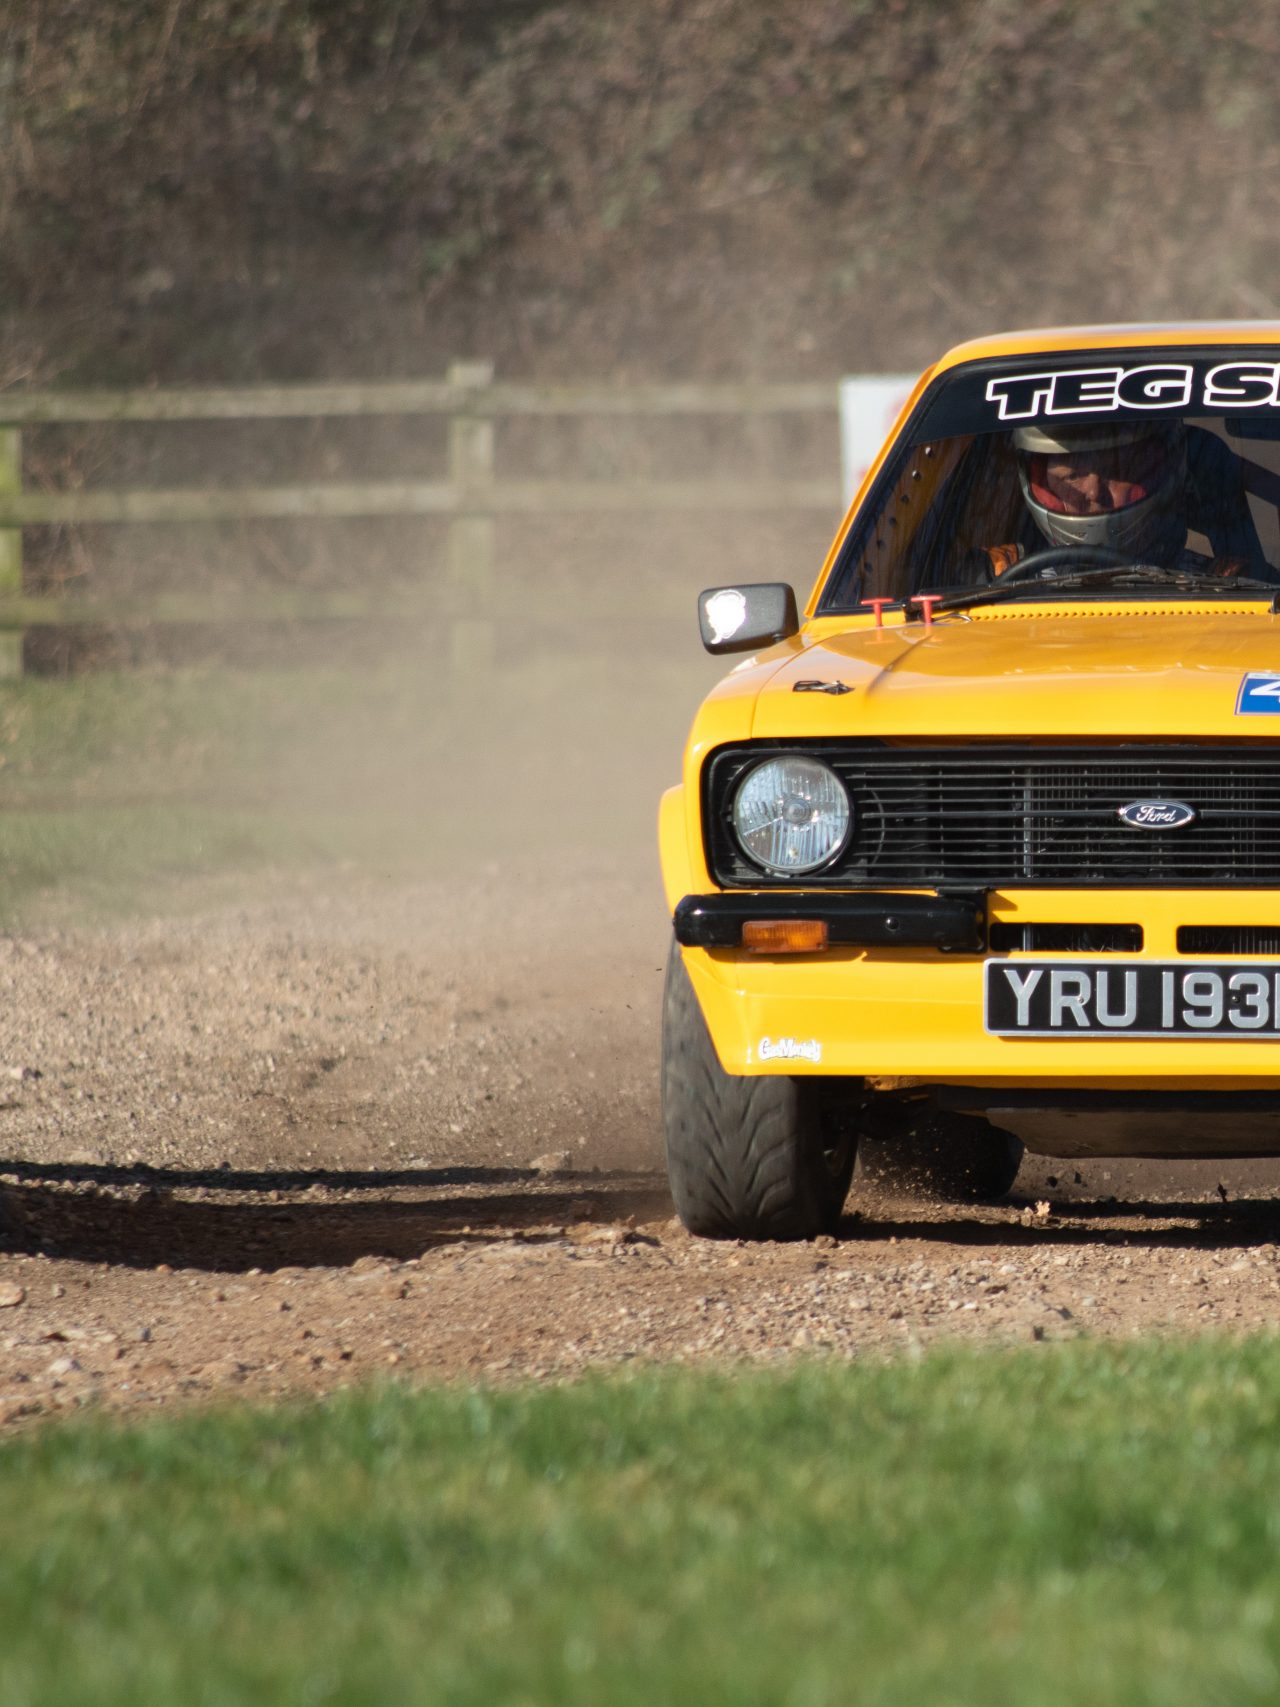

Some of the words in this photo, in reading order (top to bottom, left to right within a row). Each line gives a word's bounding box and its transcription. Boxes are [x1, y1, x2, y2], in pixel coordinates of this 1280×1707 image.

[987, 366, 1192, 419] TEG
[1136, 805, 1177, 822] Ford
[1003, 969, 1137, 1027] YRU
